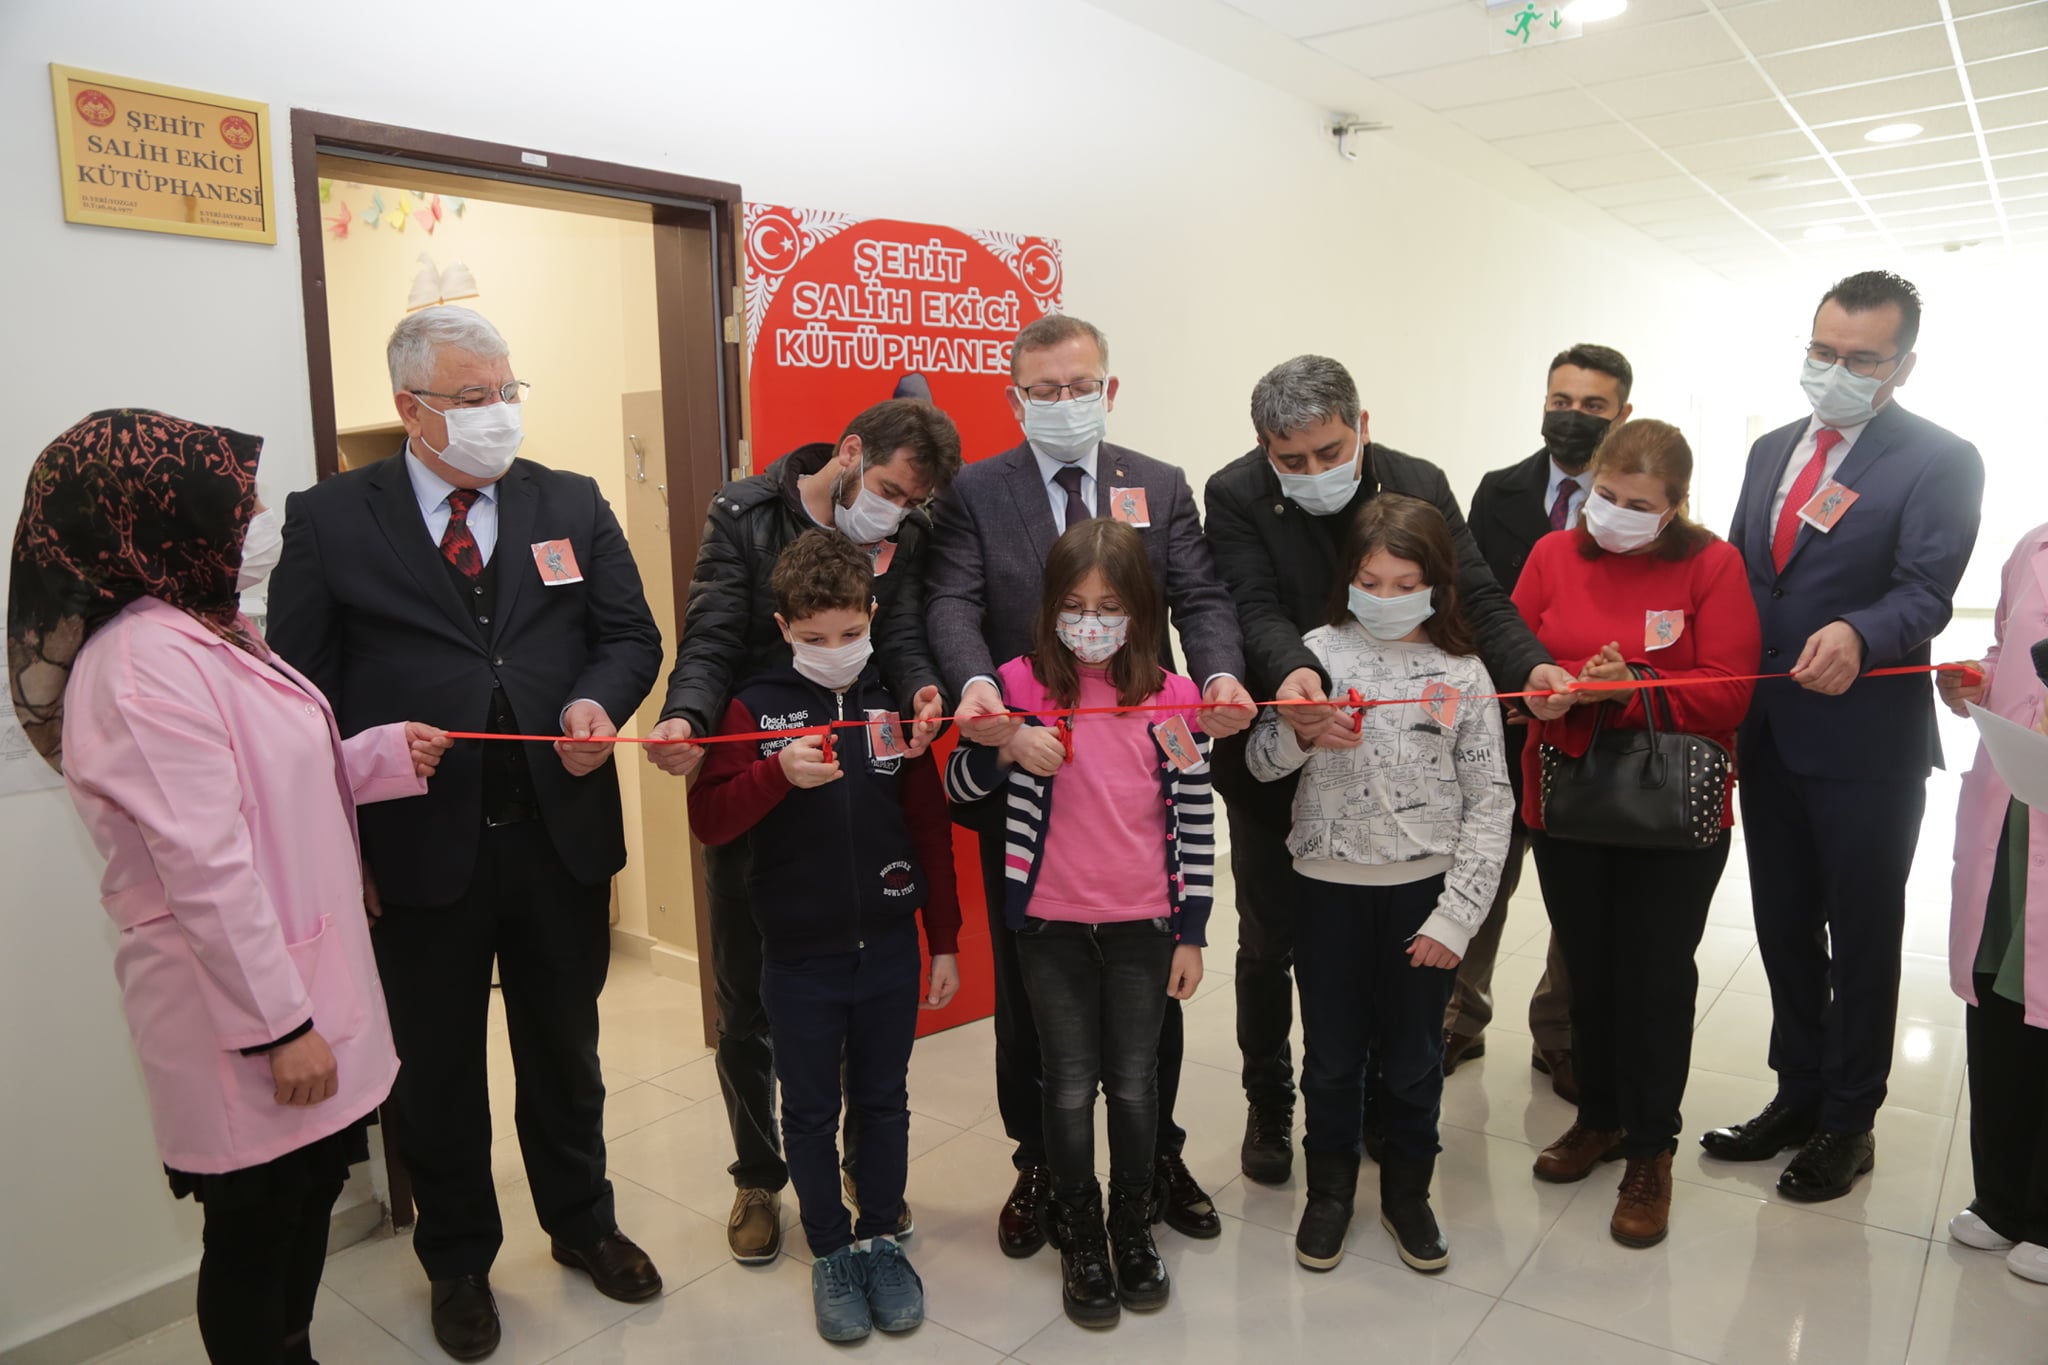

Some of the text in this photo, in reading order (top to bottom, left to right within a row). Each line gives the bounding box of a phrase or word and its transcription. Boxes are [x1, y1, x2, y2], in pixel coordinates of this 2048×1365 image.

[126, 109, 206, 140] ŞEHİT
[87, 134, 244, 175] SALİH EKİCİ
[77, 163, 263, 206] KÜTÜPHANESİ
[853, 238, 967, 283] ŞEHİT
[792, 279, 1020, 332] SALİH EKİCİ
[776, 322, 1013, 375] KÜTÜPHANES
[788, 710, 809, 722] 1985
